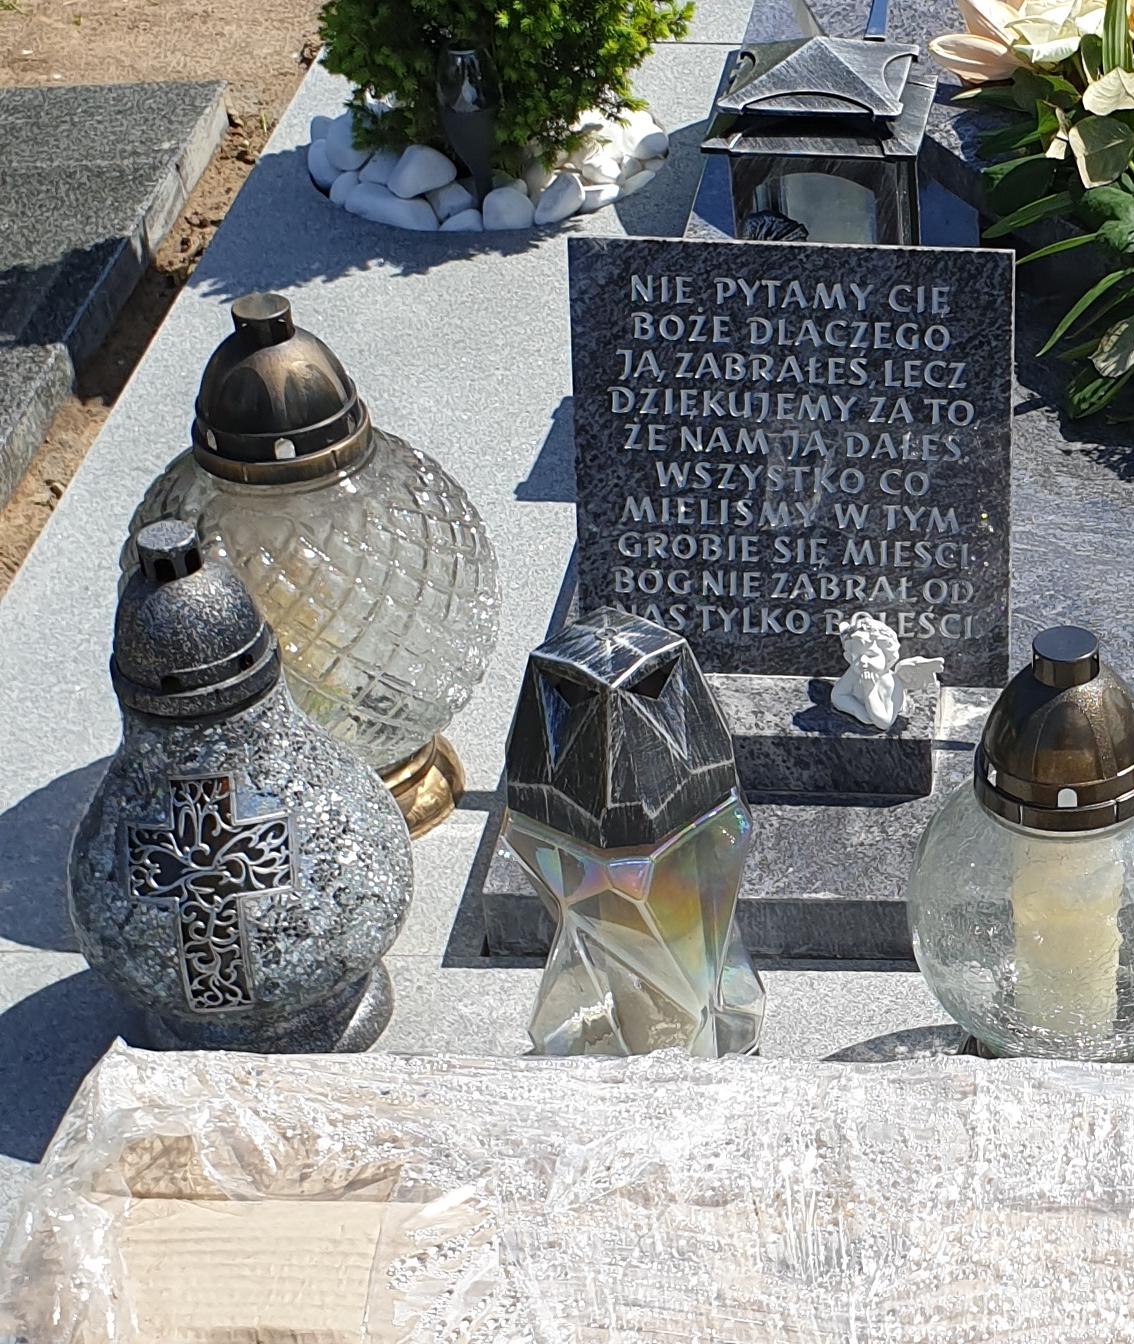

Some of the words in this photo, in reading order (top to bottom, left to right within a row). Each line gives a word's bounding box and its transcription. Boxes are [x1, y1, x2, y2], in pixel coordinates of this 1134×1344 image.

[630, 274, 695, 304] NIE
[714, 276, 874, 311] PYTAMY
[888, 285, 951, 318] CIĘ
[631, 306, 731, 343] BOŻE
[747, 317, 951, 352] DLACZEGO
[883, 360, 967, 389] LECZ
[607, 386, 858, 423] DZIĘKUJEMY
[867, 397, 914, 423] ZA
[923, 399, 976, 426] TO
[623, 416, 668, 451] ŻE
[680, 425, 770, 455] NAM
[655, 461, 866, 495] WSZYSTKO
[879, 468, 931, 496] CO
[621, 493, 817, 529] MIELIŚMY
[834, 503, 871, 530] W
[882, 505, 960, 535] TYM
[617, 530, 760, 563] GROBIE
[773, 535, 829, 569] SIĘ
[611, 562, 693, 595] BÓG
[702, 568, 762, 598] NIE
[770, 572, 917, 605] ZABRAŁ
[922, 577, 975, 605] OD
[698, 606, 811, 635] TYLKO
